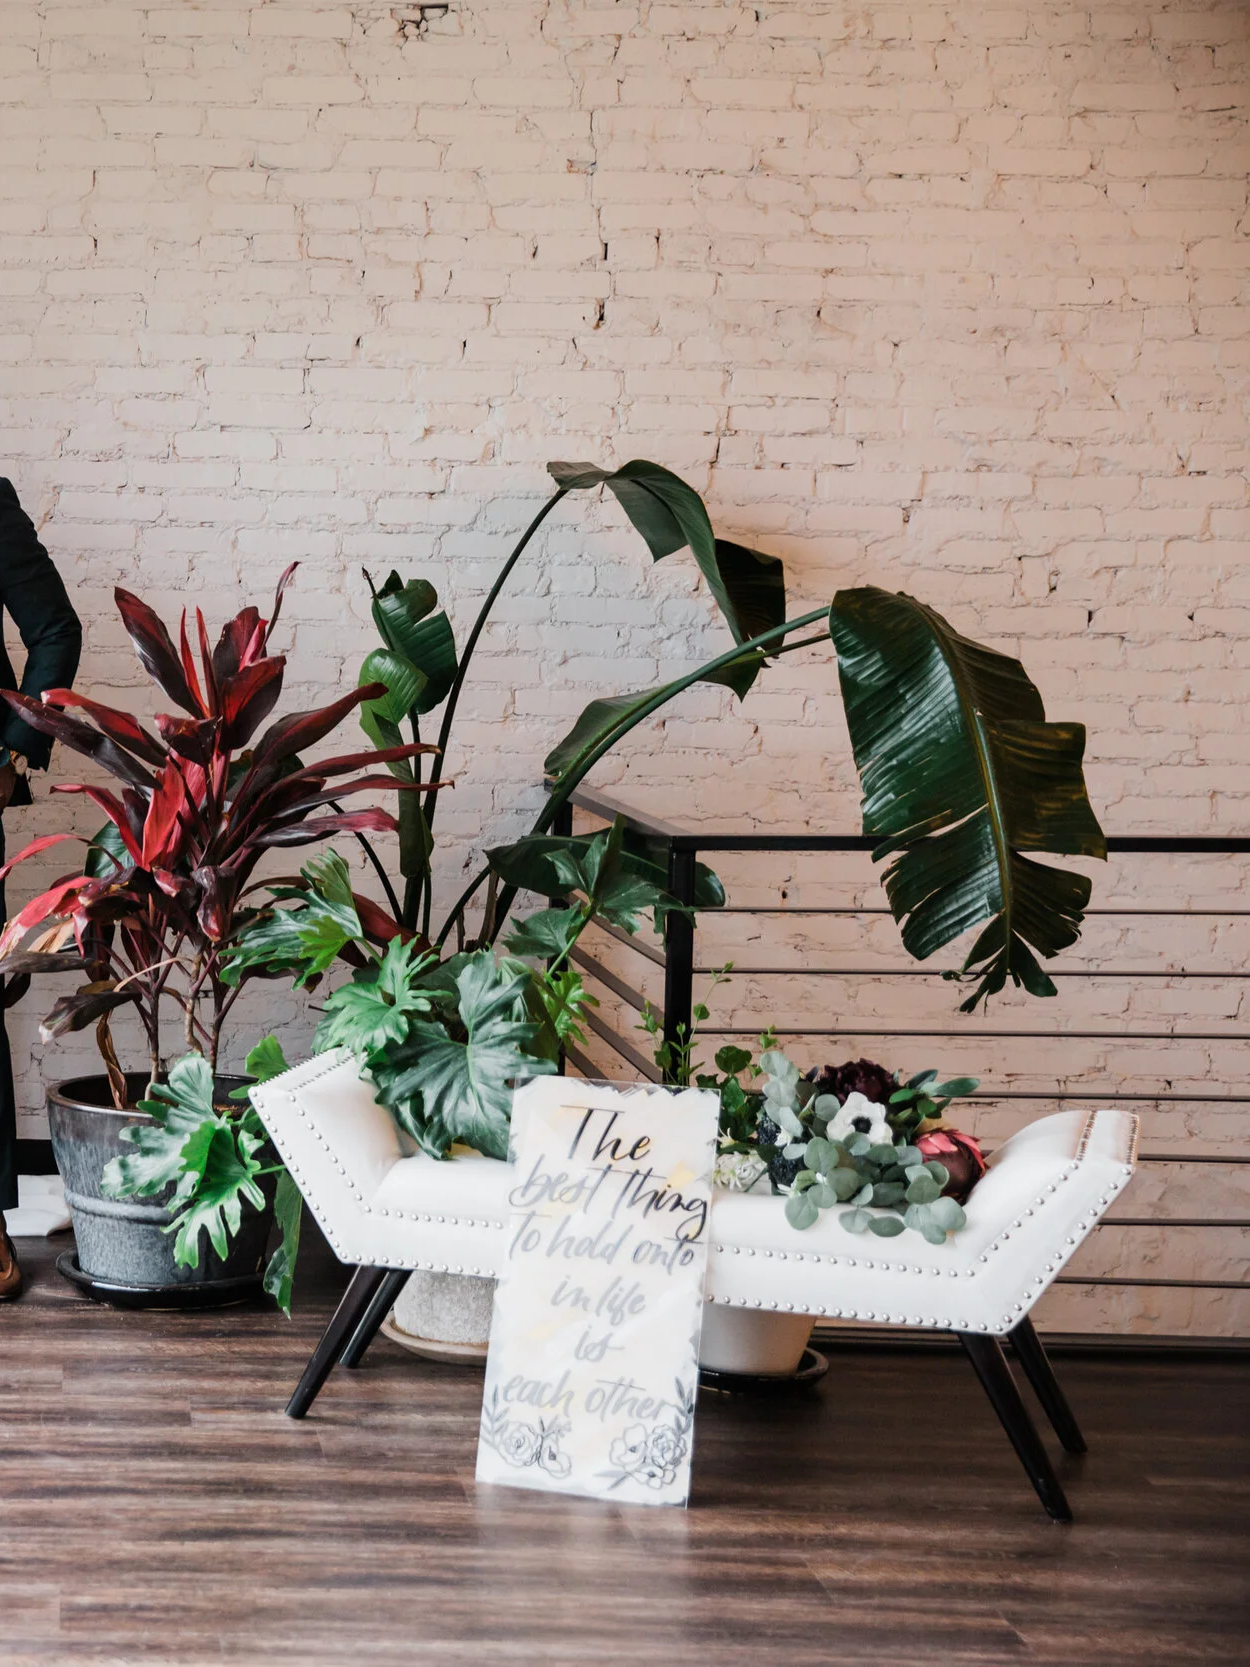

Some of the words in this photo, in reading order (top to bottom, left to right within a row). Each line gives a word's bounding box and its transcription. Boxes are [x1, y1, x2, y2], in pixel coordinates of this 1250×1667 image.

[561, 1105, 651, 1161] The
[508, 1154, 612, 1212] best
[546, 1214, 634, 1265] hold
[631, 1234, 703, 1275] onto
[550, 1275, 591, 1313] in
[595, 1277, 646, 1325] life
[574, 1325, 624, 1362] is
[502, 1371, 575, 1417] each
[585, 1376, 667, 1421] other
